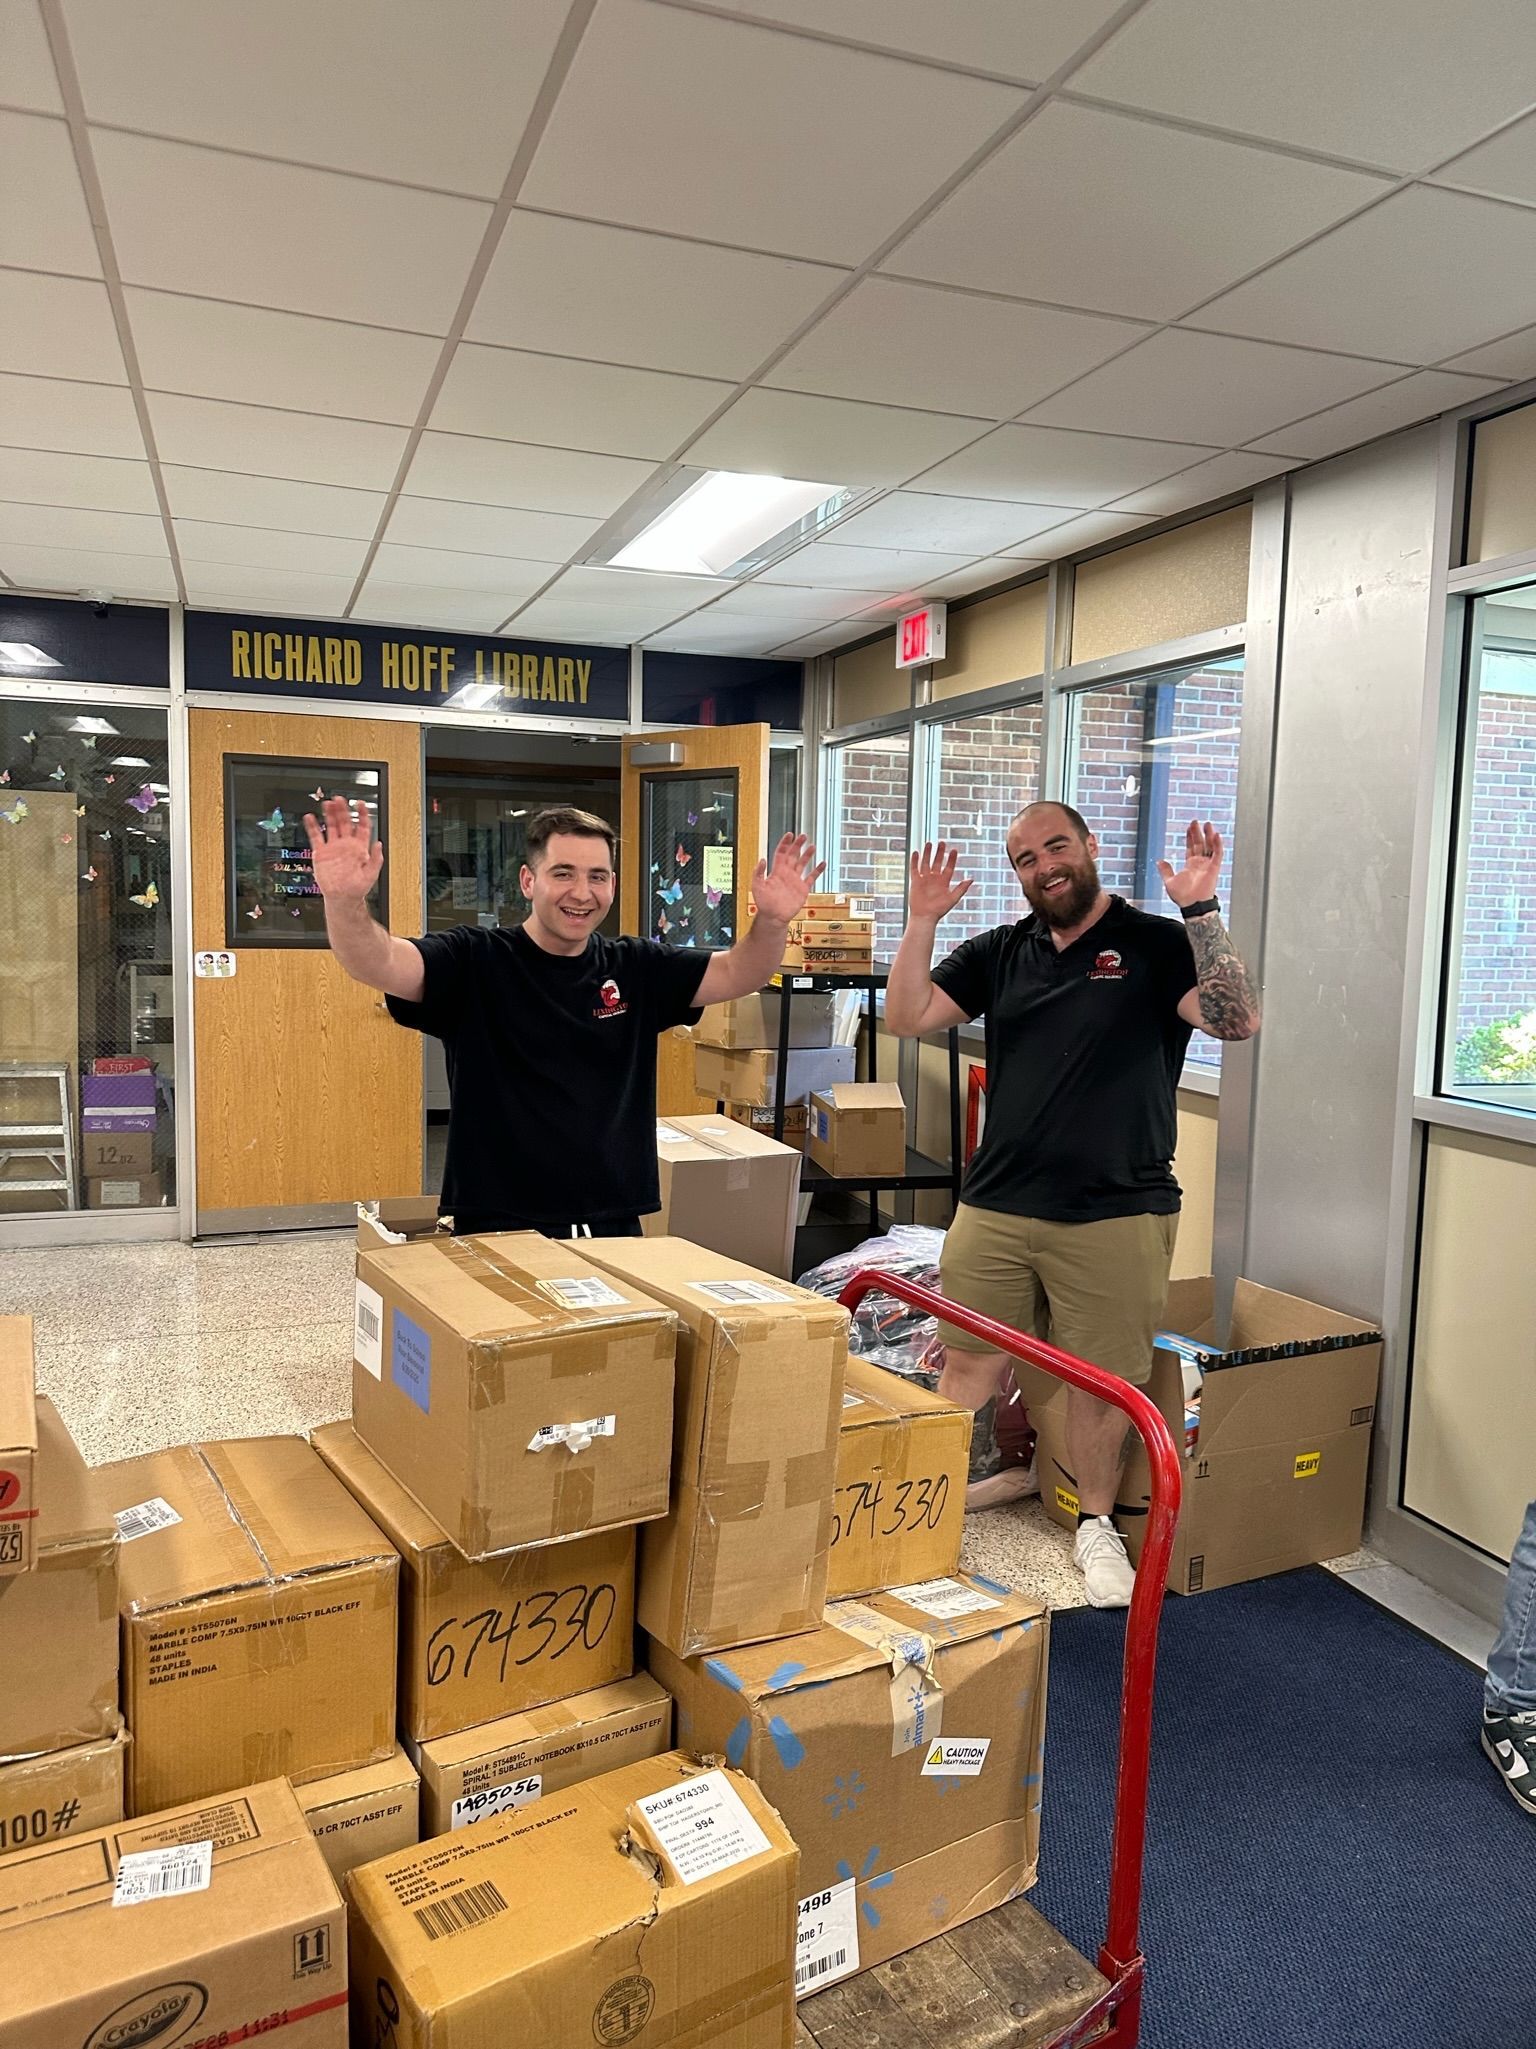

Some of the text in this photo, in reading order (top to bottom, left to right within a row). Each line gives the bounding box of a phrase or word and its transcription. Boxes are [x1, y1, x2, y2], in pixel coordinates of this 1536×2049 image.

[904, 611, 928, 661] EXIT
[232, 630, 592, 704] RICHARD HOFF LIBRARY
[109, 1063, 134, 1072] FIRST
[97, 1146, 118, 1165] 12
[1297, 1458, 1320, 1472] HEAVY
[149, 1601, 361, 1652] MARBLE COMP 7.5X9.75IN WR 100CT BLACK EFF
[149, 1630, 177, 1641] Model
[428, 1584, 616, 1685] 674330
[150, 1650, 186, 1664] 48 units
[149, 1659, 192, 1675] STAPLES
[149, 1664, 218, 1685] MADE IN INDIA
[463, 1717, 663, 1787] SPIRAL 1 SUBJECT NOTEBOOK 8X10.5 CR 70CT ASST EFF
[946, 1747, 985, 1757] CAUTION
[463, 1767, 484, 1778] Model
[493, 1752, 526, 1768] ST54891C
[462, 1782, 490, 1795] 48 Units
[644, 1783, 710, 1813] SKU#:674330
[325, 1823, 339, 1834] CR
[340, 1816, 362, 1829] 70CT
[363, 1810, 386, 1823] ASST
[387, 1804, 403, 1816] EFF
[694, 1817, 715, 1830] 994
[239, 1831, 251, 1840] IN
[389, 1808, 578, 1886] MARBLE COMP 7.5X9.75IN WR 100CT BLACK EFF
[385, 1866, 411, 1880] Model
[394, 1876, 429, 1893] 48 units
[398, 1880, 438, 1900] STAPLES
[401, 1877, 466, 1907] MADE IN INDIA
[818, 1922, 824, 1935] 7
[308, 1967, 322, 1976] Way
[322, 1962, 333, 1970] Up
[106, 1997, 180, 2044] Crayola
